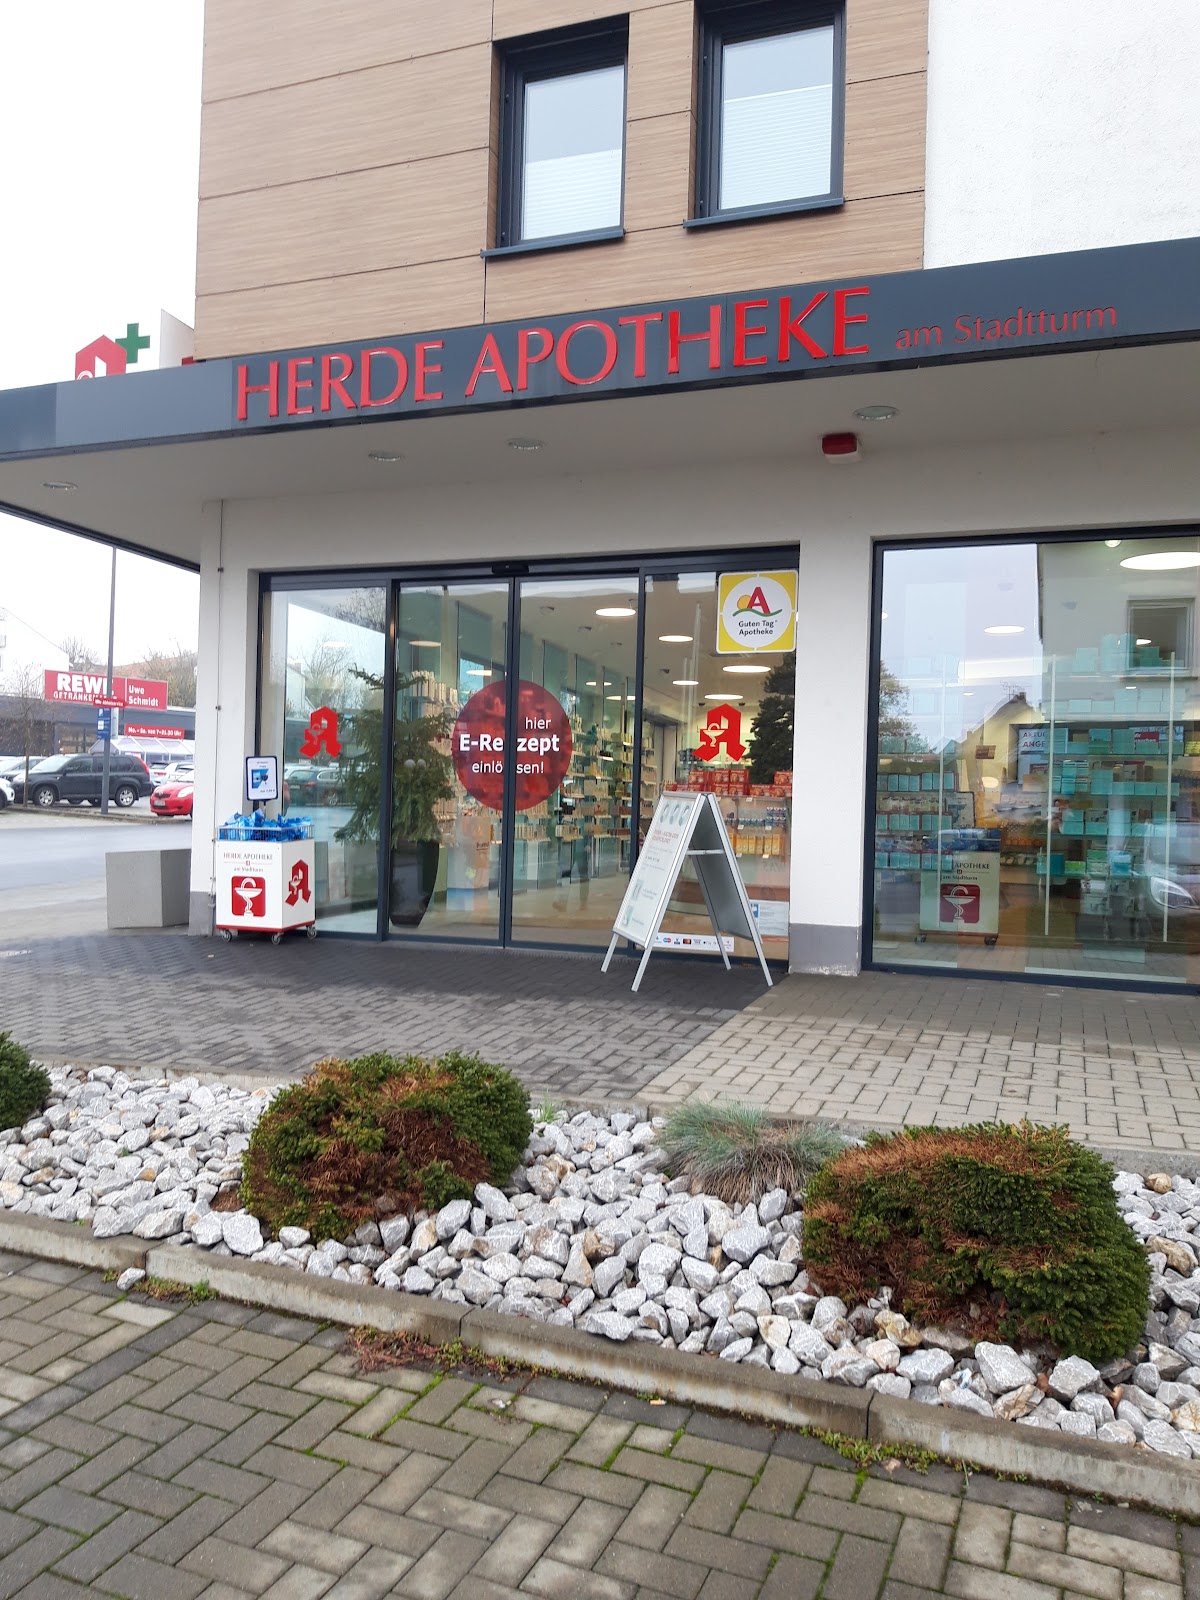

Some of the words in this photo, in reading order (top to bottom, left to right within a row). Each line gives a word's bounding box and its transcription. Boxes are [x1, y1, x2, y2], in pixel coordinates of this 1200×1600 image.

[237, 340, 444, 421] HERDE
[465, 286, 871, 397] APOTHEKE
[896, 325, 942, 349] am
[954, 306, 1117, 343] Stadtturm
[739, 628, 773, 637] Apotheke
[129, 685, 145, 695] Uwe
[129, 696, 158, 707] Schmidt
[525, 717, 551, 729] hier
[955, 862, 990, 870] APOTHEKE
